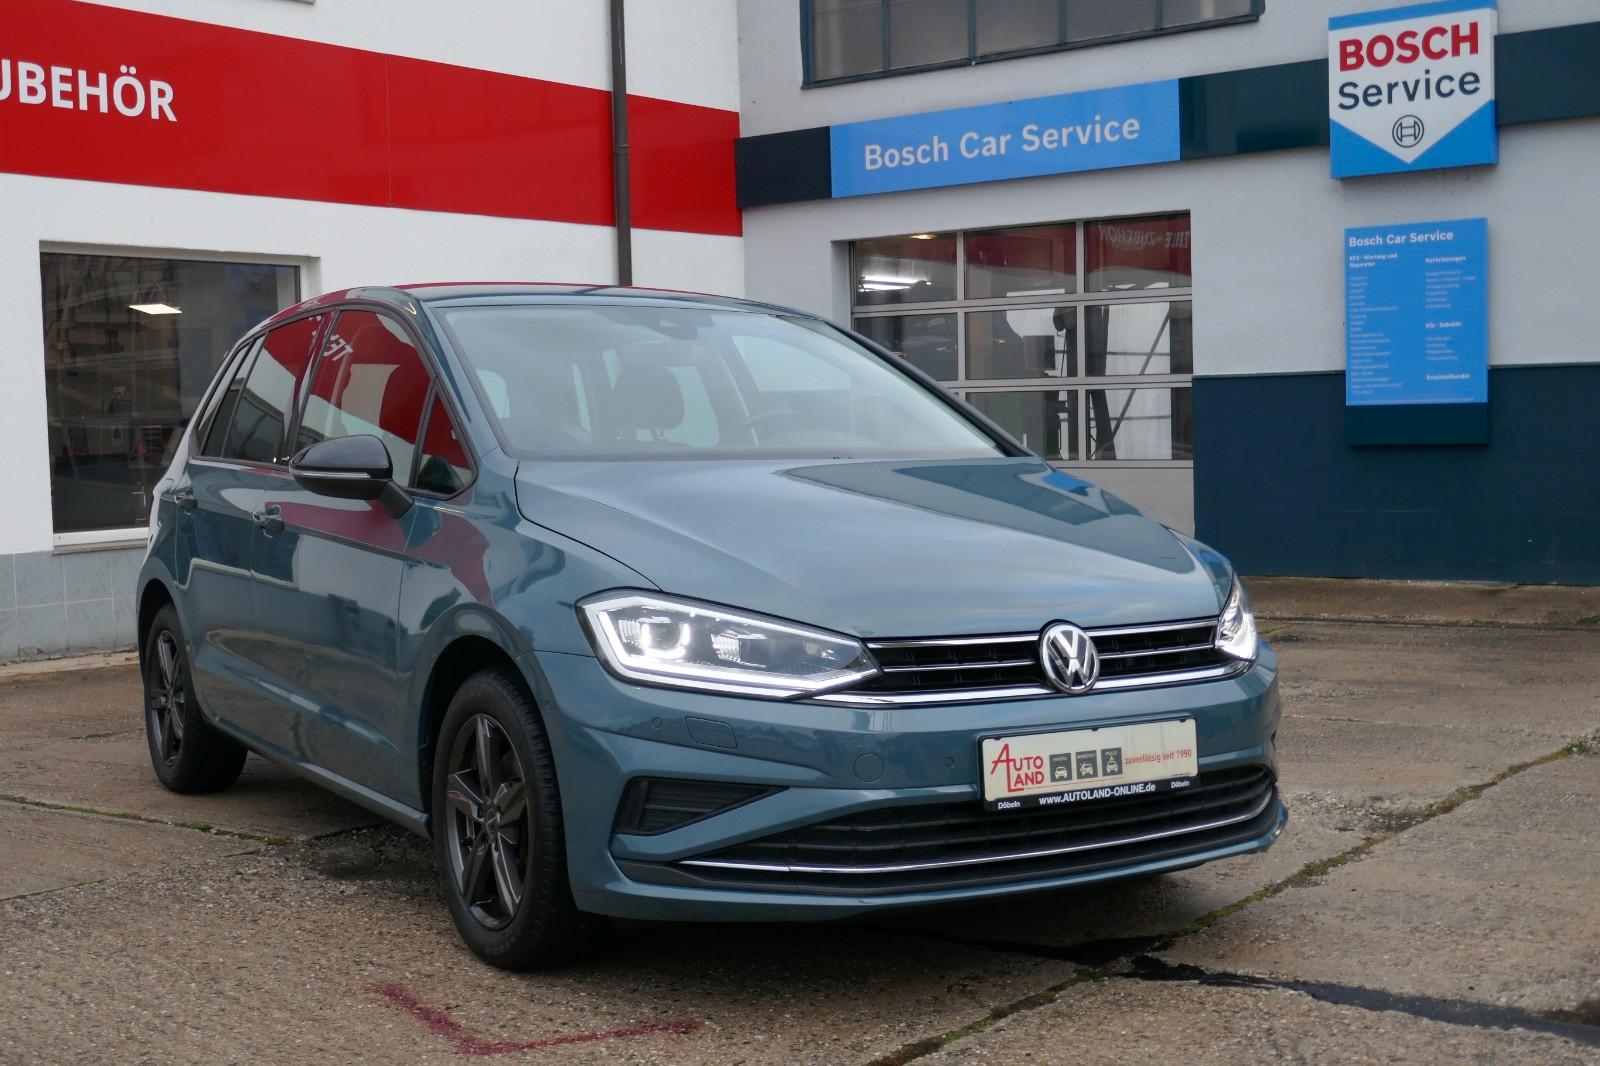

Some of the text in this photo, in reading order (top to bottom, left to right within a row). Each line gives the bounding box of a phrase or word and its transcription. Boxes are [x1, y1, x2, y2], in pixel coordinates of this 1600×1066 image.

[1339, 21, 1479, 72] BOSCH
[1338, 69, 1480, 110] Service
[864, 114, 1141, 171] Bosch Car Service
[1348, 229, 1454, 248] Bosch Car Service
[990, 743, 1044, 776] AUTO
[1124, 752, 1161, 765] zuverlässig
[1162, 751, 1174, 760] seit
[1176, 748, 1192, 759] 1990
[1038, 783, 1156, 805] www.AUTOLAND-ONLINE.de
